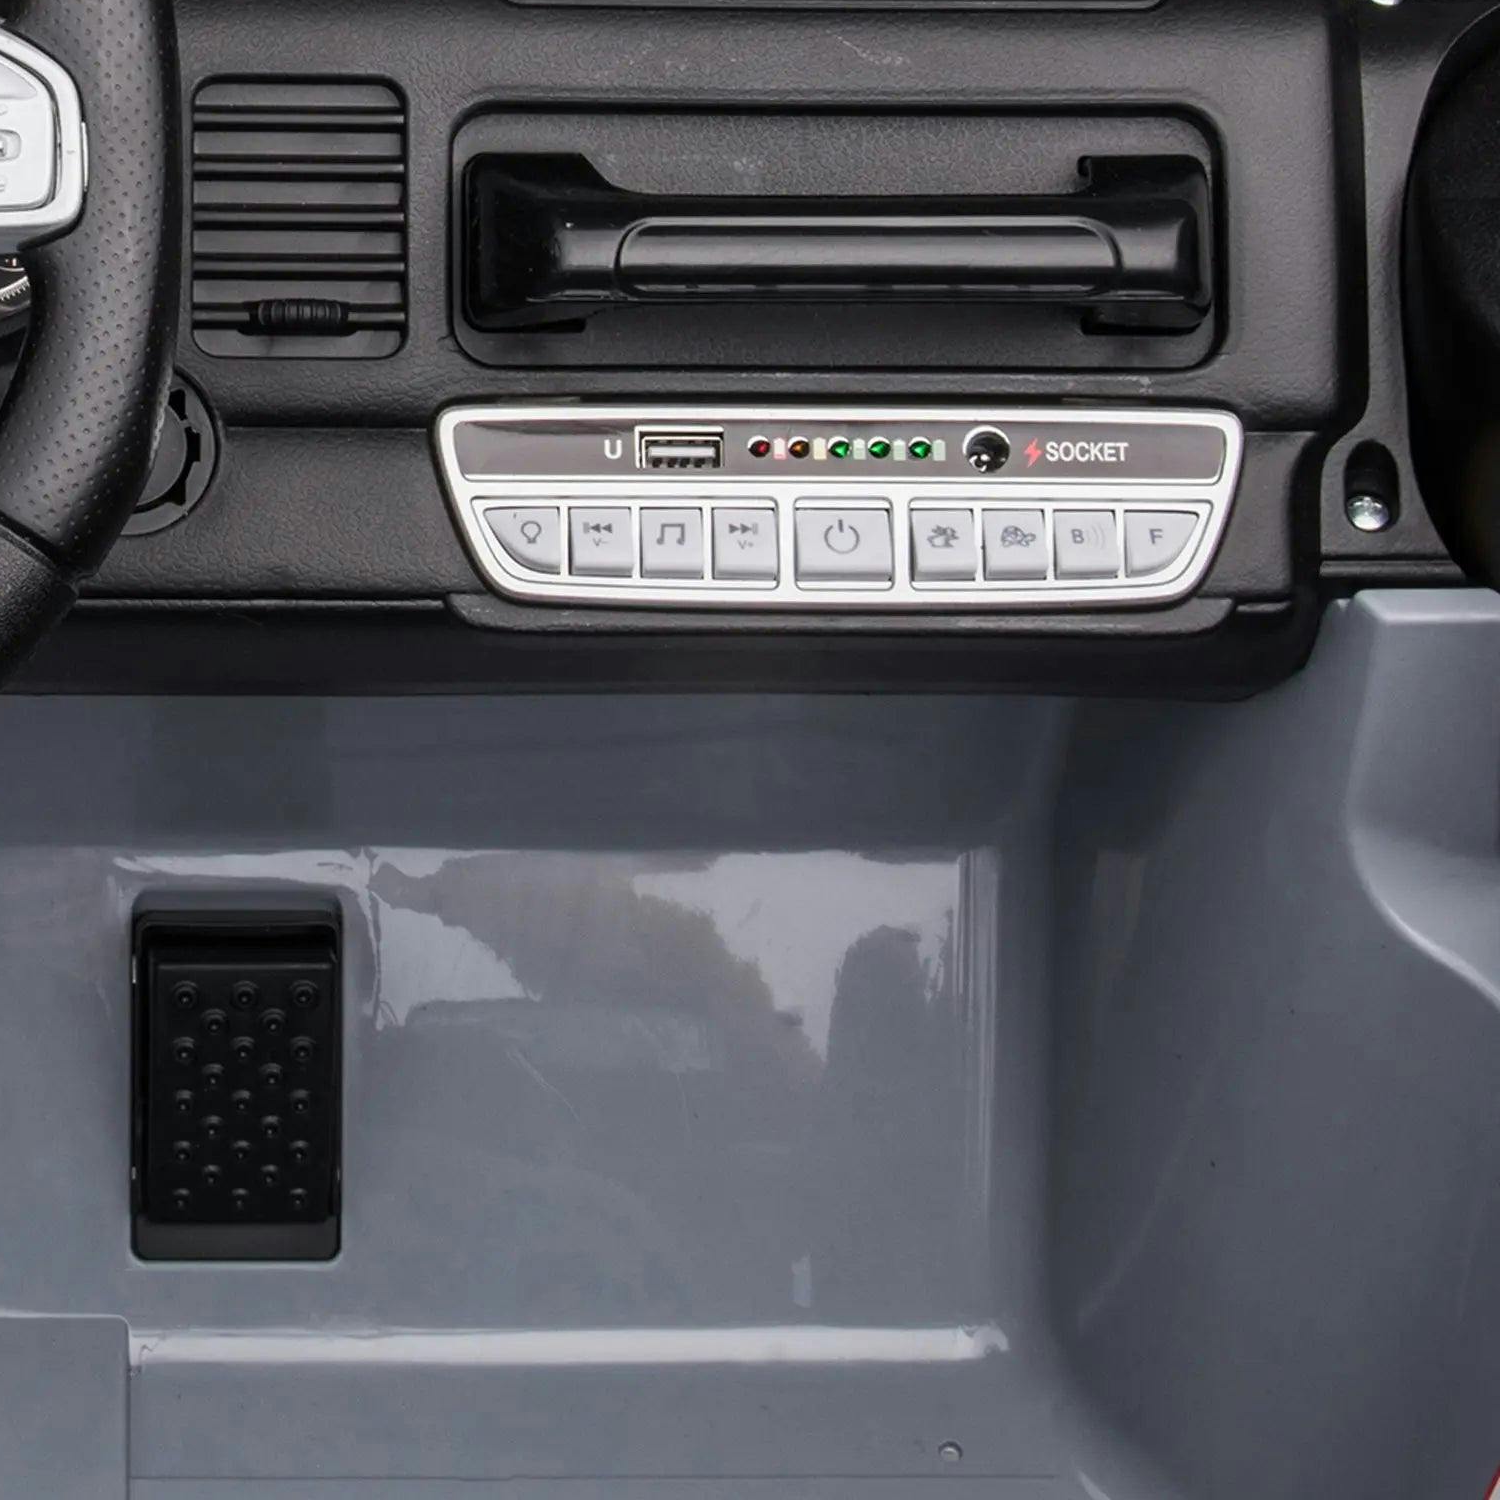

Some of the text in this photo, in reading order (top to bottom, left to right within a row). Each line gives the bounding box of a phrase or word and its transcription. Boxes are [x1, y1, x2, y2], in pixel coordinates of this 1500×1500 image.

[604, 438, 622, 460] U
[1045, 441, 1129, 463] SOCKET
[1071, 528, 1085, 545] B
[1149, 528, 1163, 545] F
